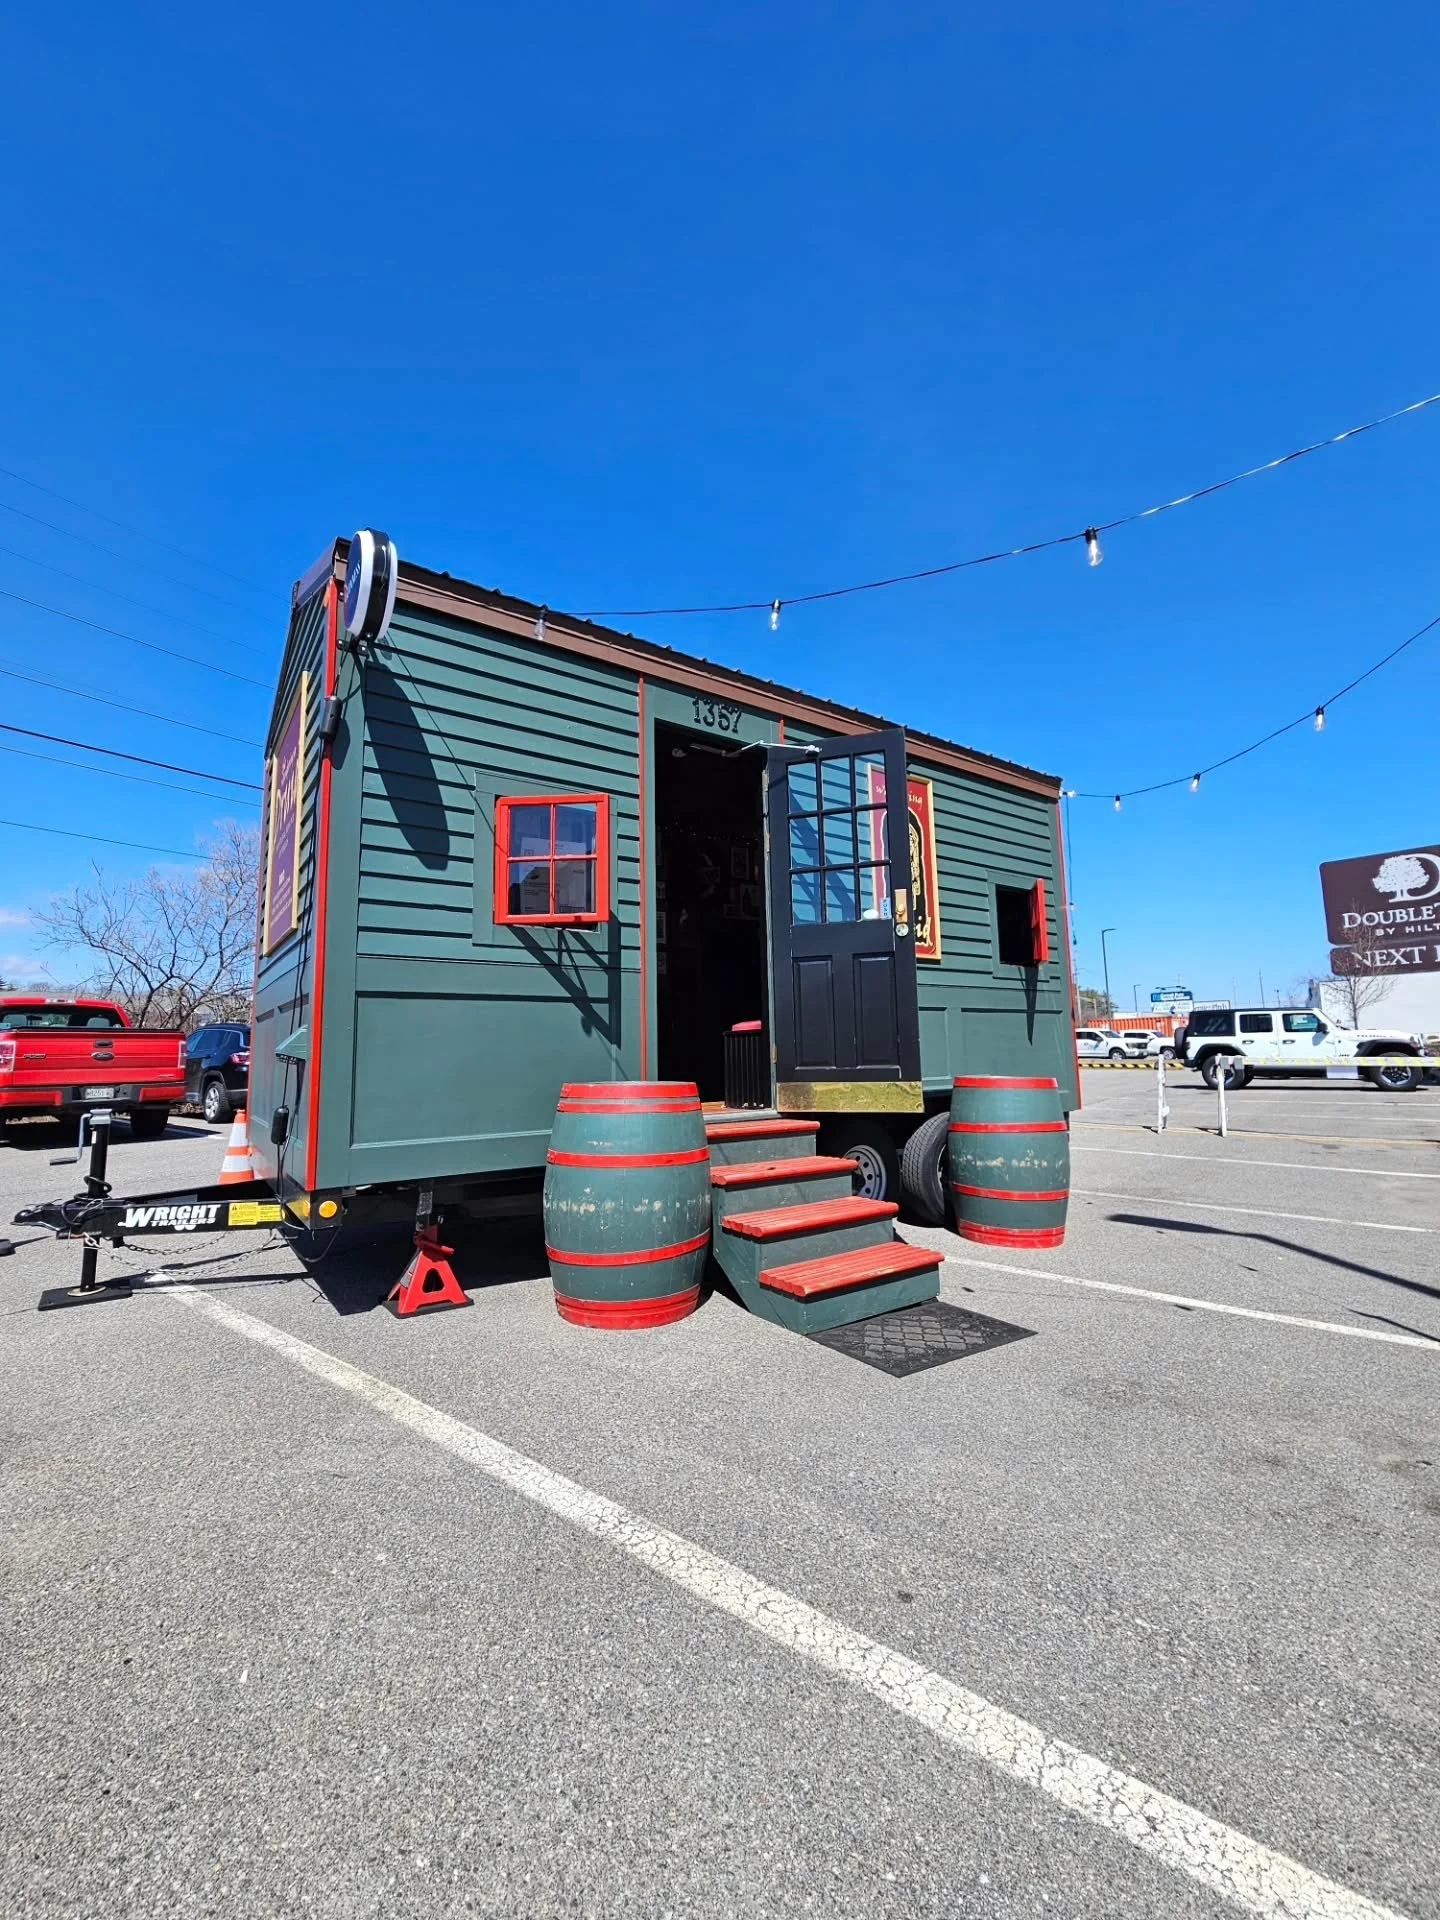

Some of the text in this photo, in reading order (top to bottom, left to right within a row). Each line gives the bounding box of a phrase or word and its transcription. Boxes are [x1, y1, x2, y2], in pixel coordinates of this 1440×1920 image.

[692, 697, 742, 734] 1357
[1375, 927, 1396, 936] BY
[1351, 945, 1427, 968] NEXT
[125, 1204, 221, 1228] WRIGHT
[150, 1217, 217, 1227] TRAILERS
